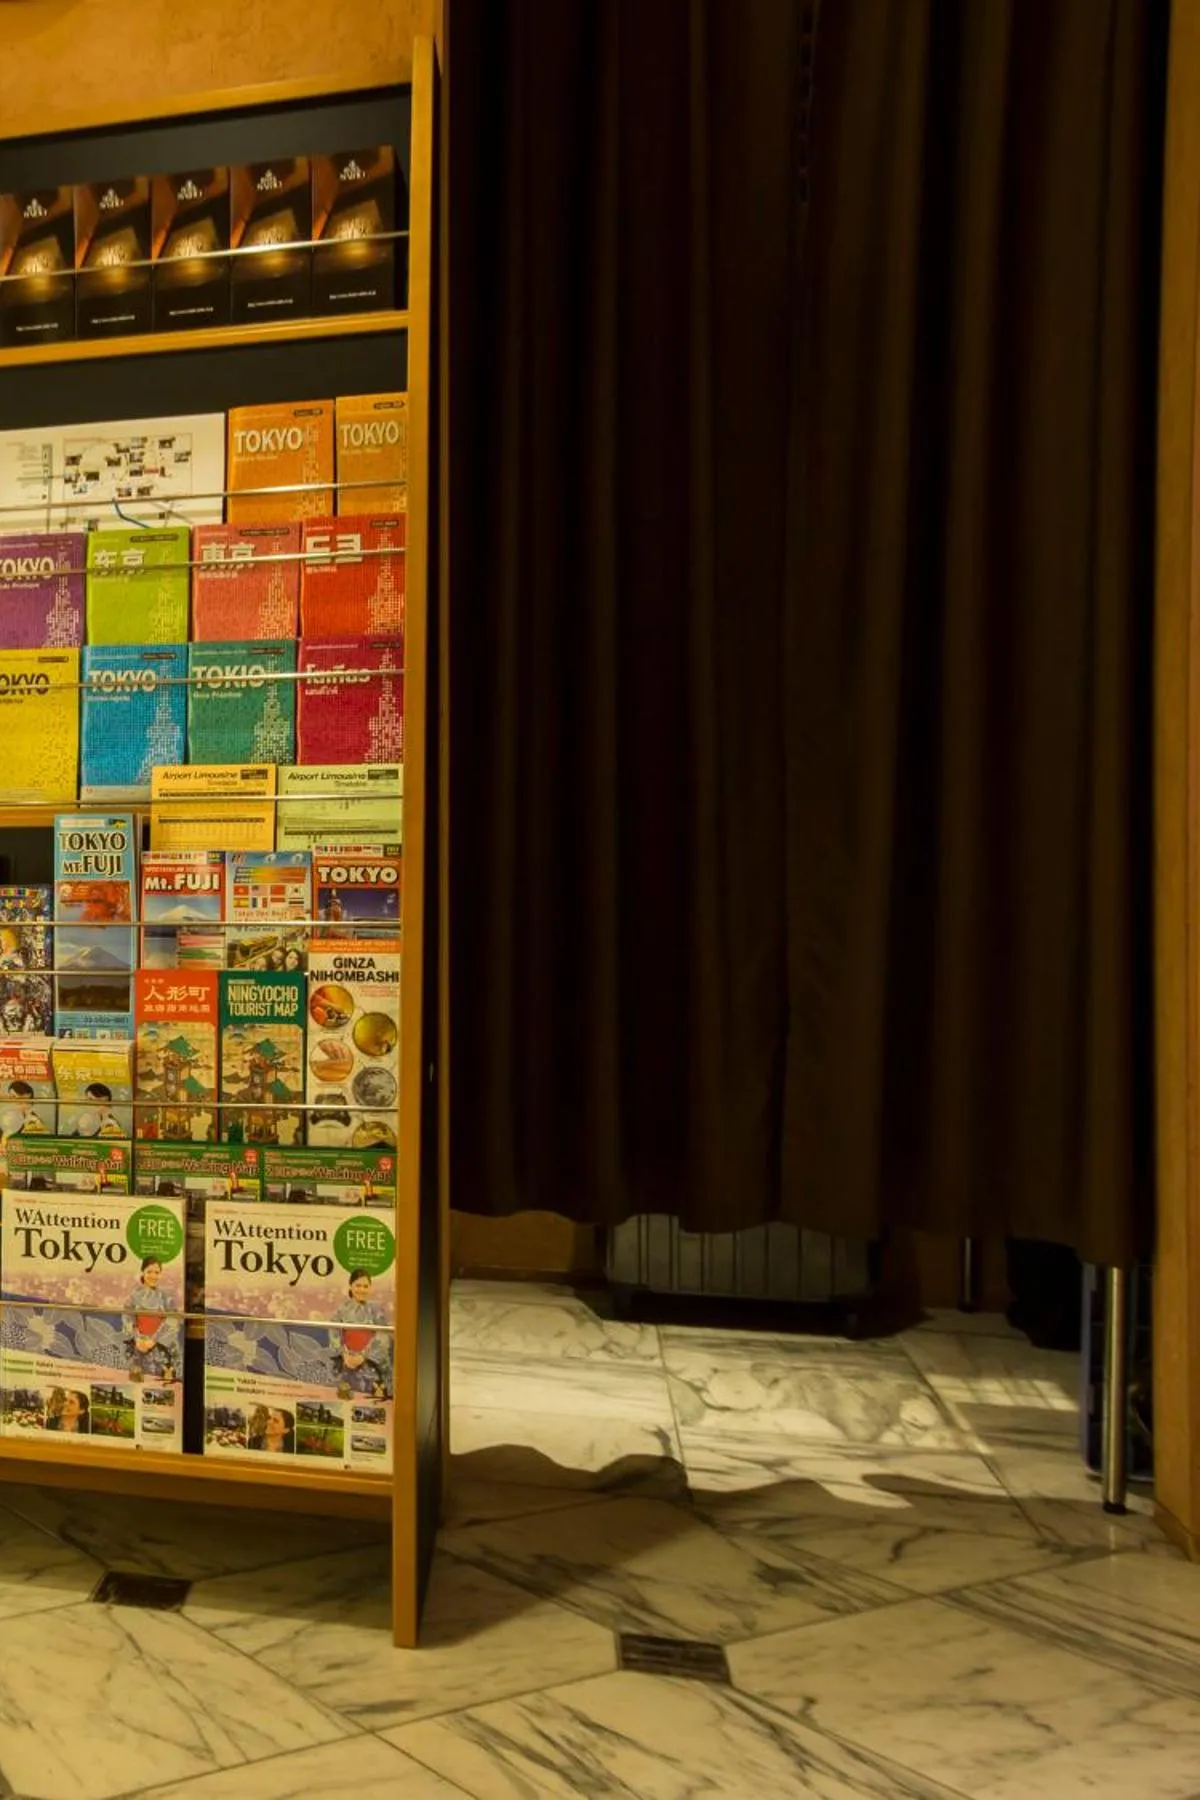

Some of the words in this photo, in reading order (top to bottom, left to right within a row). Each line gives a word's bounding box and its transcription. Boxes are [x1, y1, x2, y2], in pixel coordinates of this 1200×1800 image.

[234, 427, 303, 453] TOKYO
[341, 420, 399, 447] TOKYO
[89, 669, 157, 692] TOKYO
[192, 664, 265, 688] TOKIO
[163, 771, 192, 782] Airport
[194, 770, 238, 780] Limousine
[288, 771, 319, 782] Airport
[320, 771, 367, 781] Limousine
[59, 831, 126, 851] TOKYO
[82, 854, 122, 876] FUJI
[318, 866, 398, 884] TOKYO
[145, 876, 172, 890] Mt.
[174, 873, 220, 891] FUJI
[333, 957, 376, 969] GINZA
[310, 970, 399, 983] NIHOMBASHI
[144, 985, 211, 1001] 人形町
[228, 984, 299, 1002] NINGYOCHO
[228, 1002, 271, 1017] TOURIST
[274, 1002, 299, 1017] MAP
[15, 1208, 121, 1230] WAttention
[138, 1218, 176, 1238] FREE
[214, 1219, 328, 1241] WAttention
[346, 1230, 386, 1250] FREE
[15, 1227, 128, 1272] Tokyo
[214, 1239, 335, 1286] Tokyo
